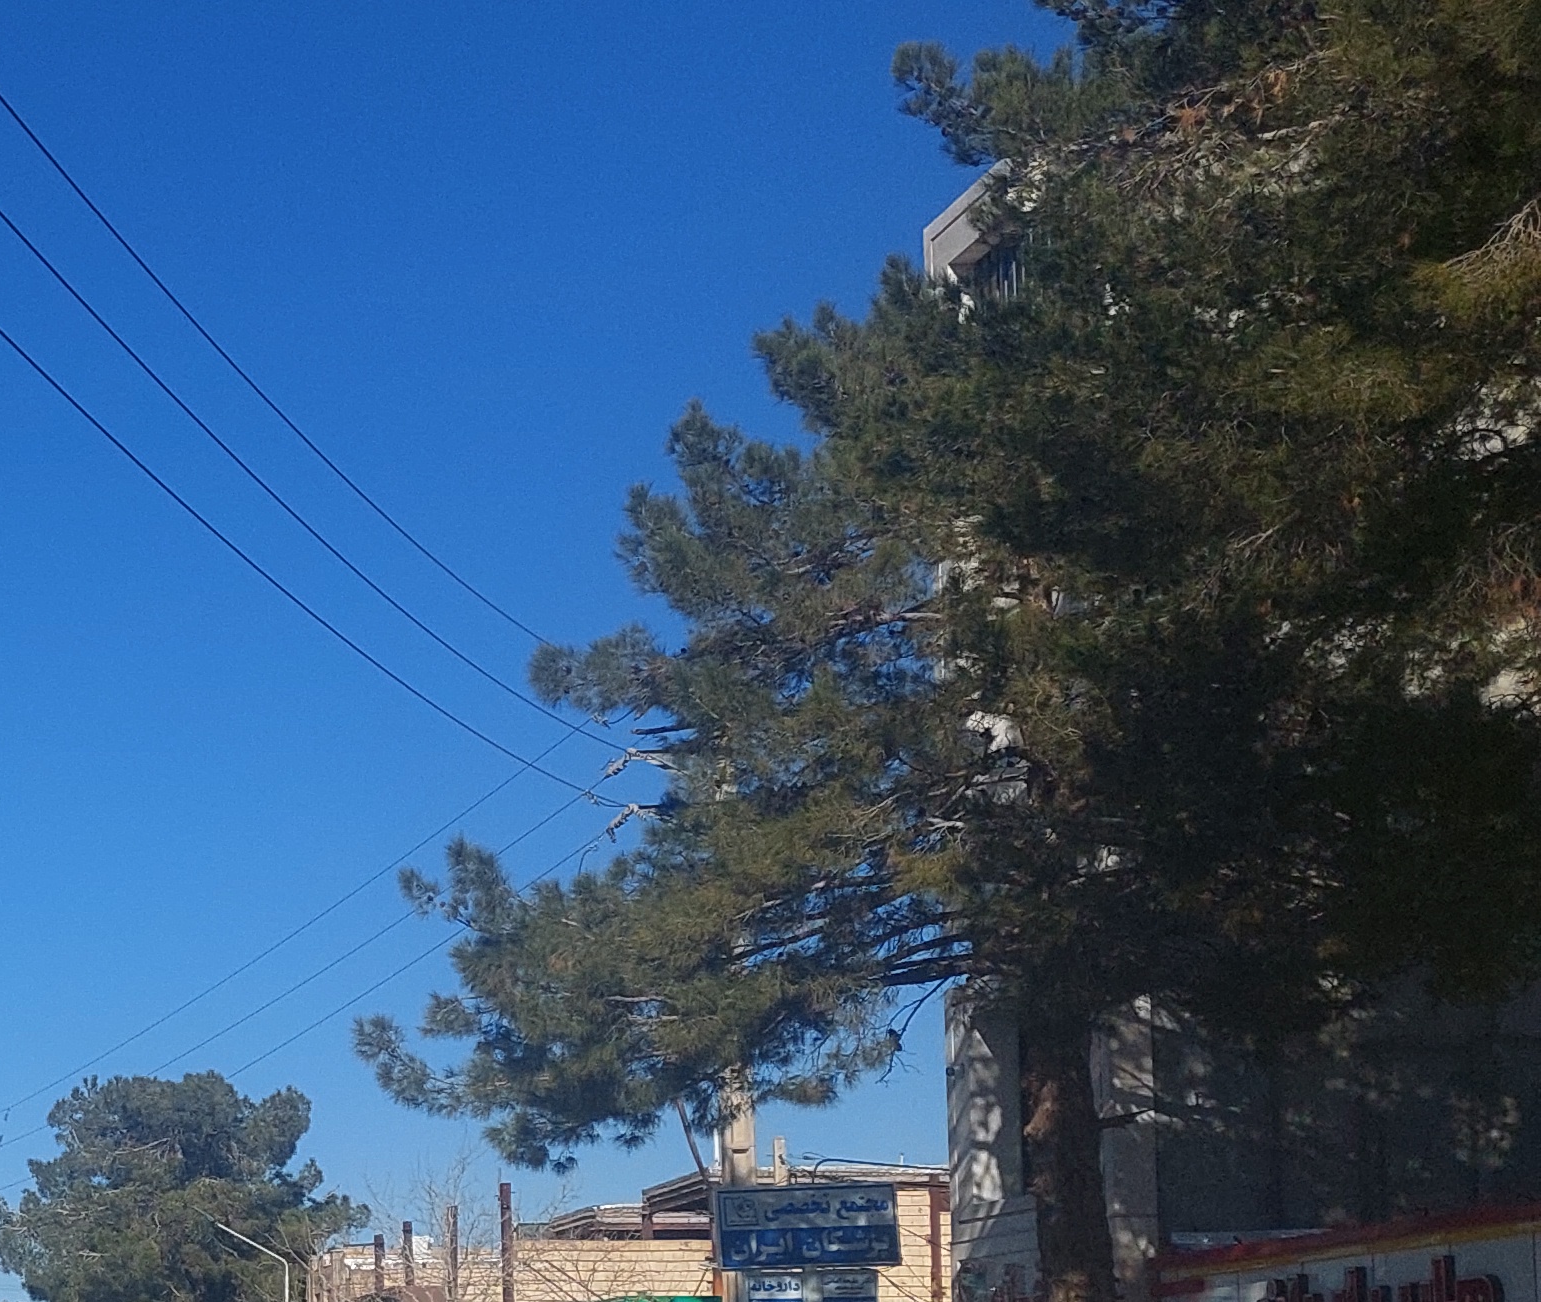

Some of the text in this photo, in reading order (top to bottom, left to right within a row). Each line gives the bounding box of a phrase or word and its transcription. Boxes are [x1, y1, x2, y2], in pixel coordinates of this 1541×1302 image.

[765, 1192, 889, 1222] مجتمع تخصصی
[731, 1230, 890, 1261] پزشکان ایران
[751, 1280, 801, 1292] داروخانه
